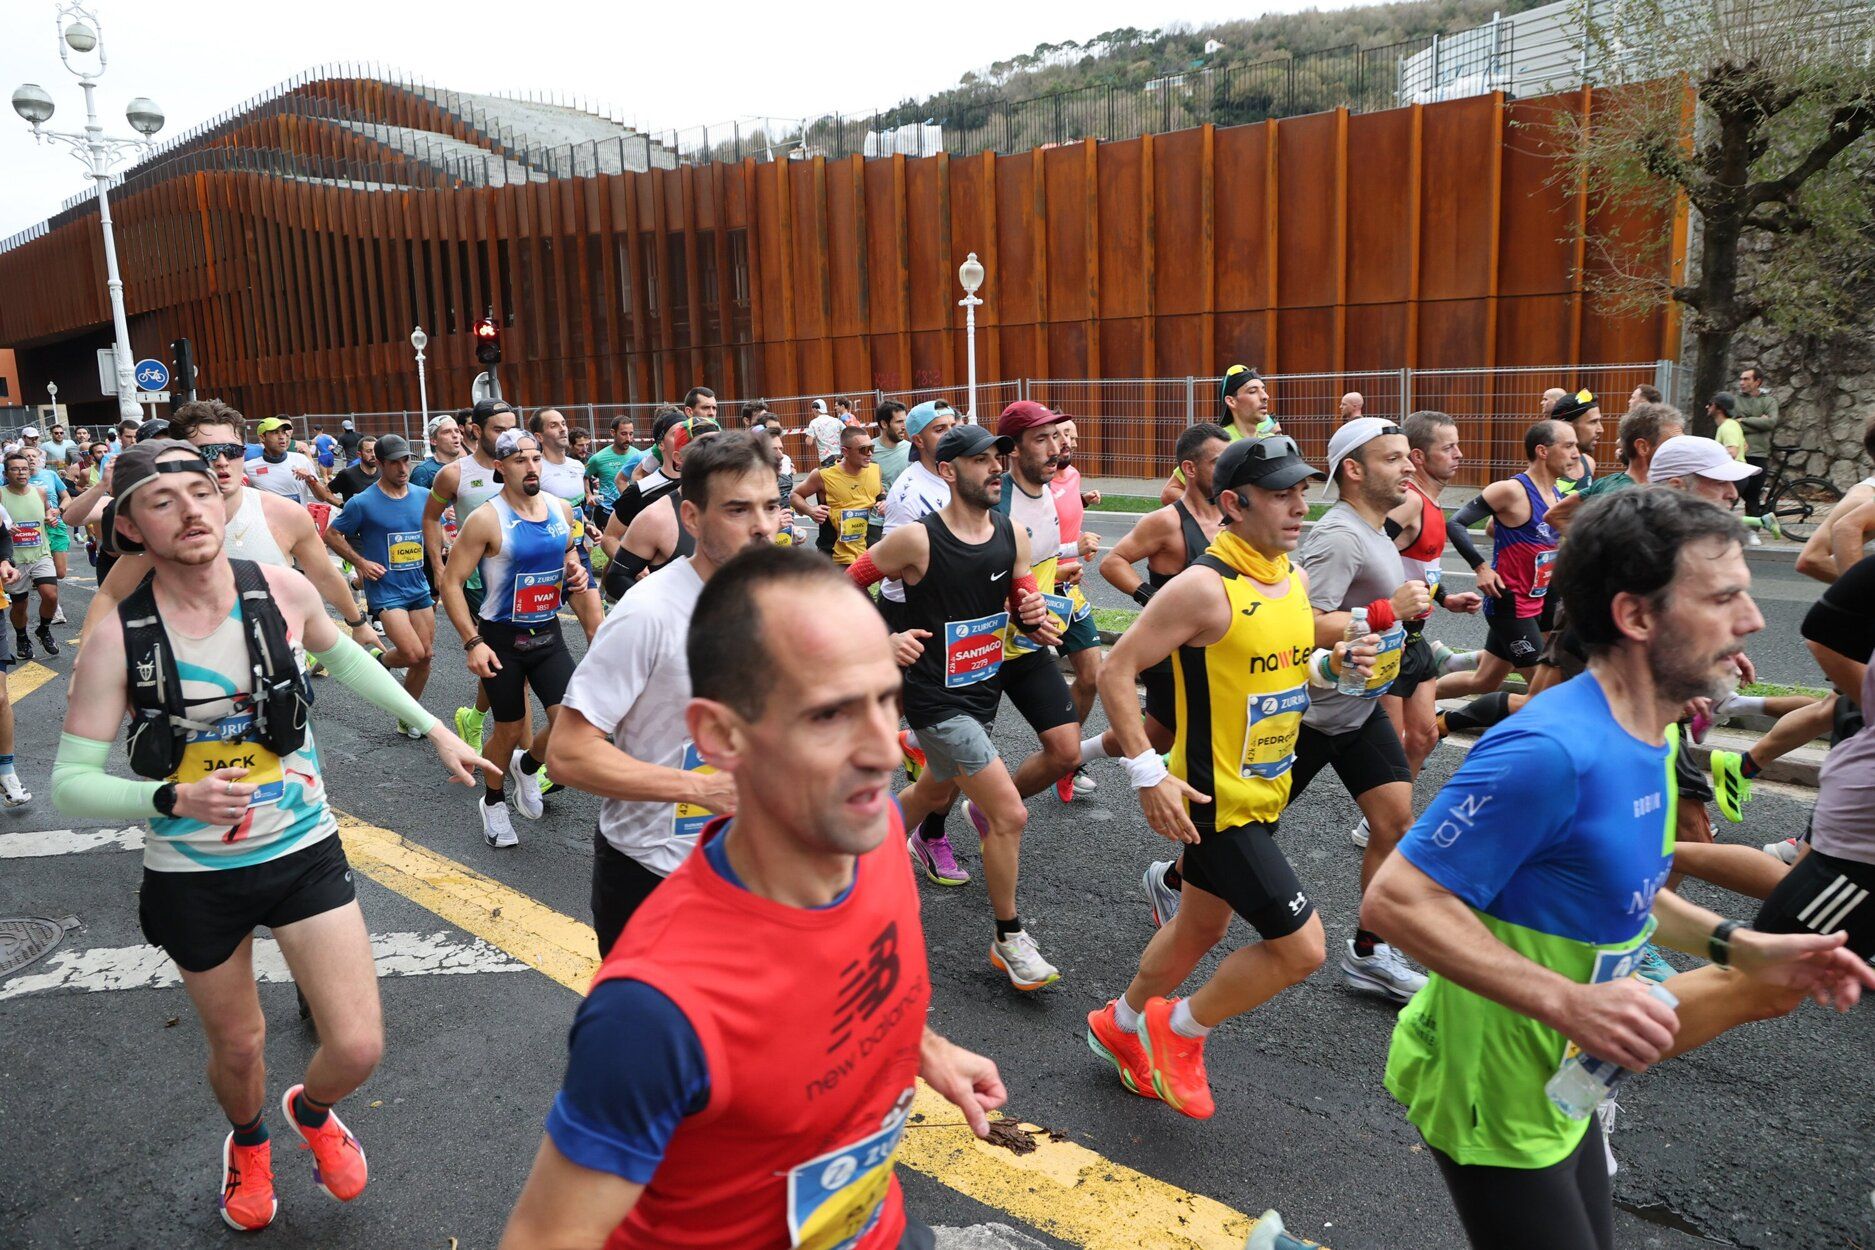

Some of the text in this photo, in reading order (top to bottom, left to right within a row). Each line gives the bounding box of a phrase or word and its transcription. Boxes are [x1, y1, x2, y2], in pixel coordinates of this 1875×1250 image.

[537, 574, 559, 584] ZURICH
[534, 592, 555, 602] IVAN
[971, 620, 998, 633] ZURICH
[955, 640, 1001, 661] SANTIAGO
[204, 754, 256, 772] JACK
[806, 1058, 855, 1101] new
